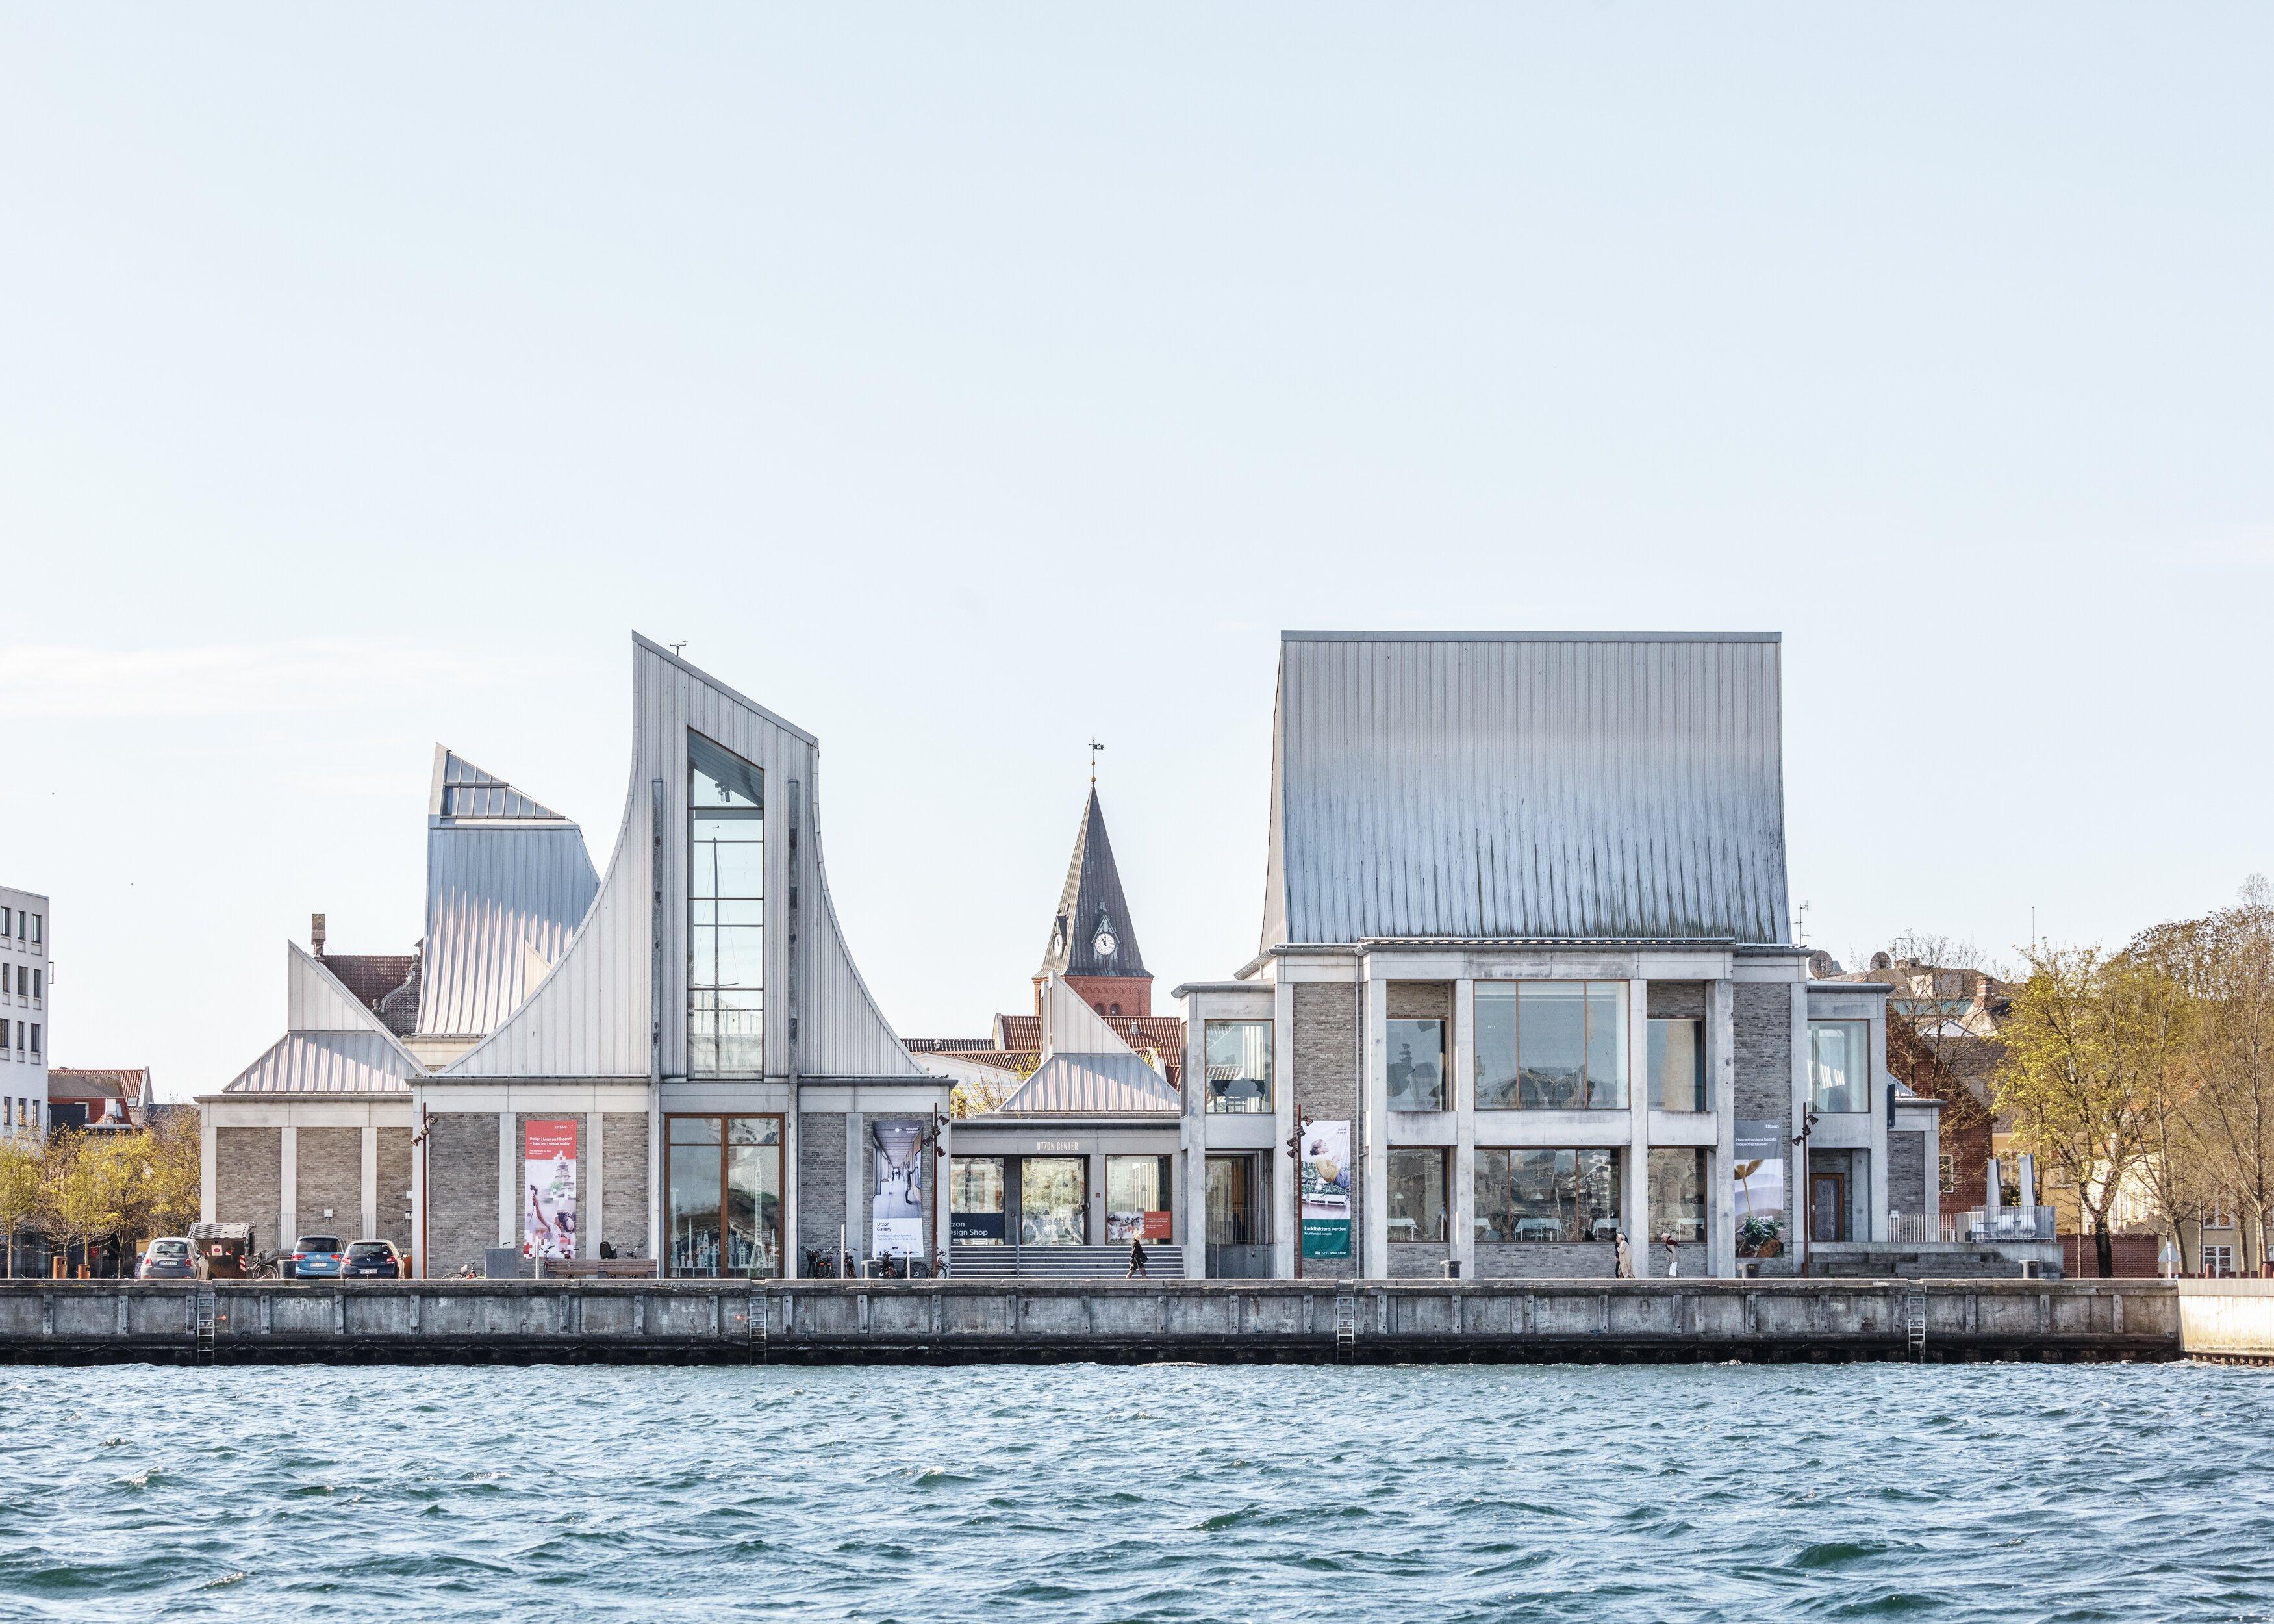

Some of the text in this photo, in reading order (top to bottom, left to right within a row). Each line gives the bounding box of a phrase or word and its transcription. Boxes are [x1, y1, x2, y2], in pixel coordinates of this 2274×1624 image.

[1037, 1141, 1078, 1150] UTZON CENTER
[969, 1228, 988, 1237] Shop
